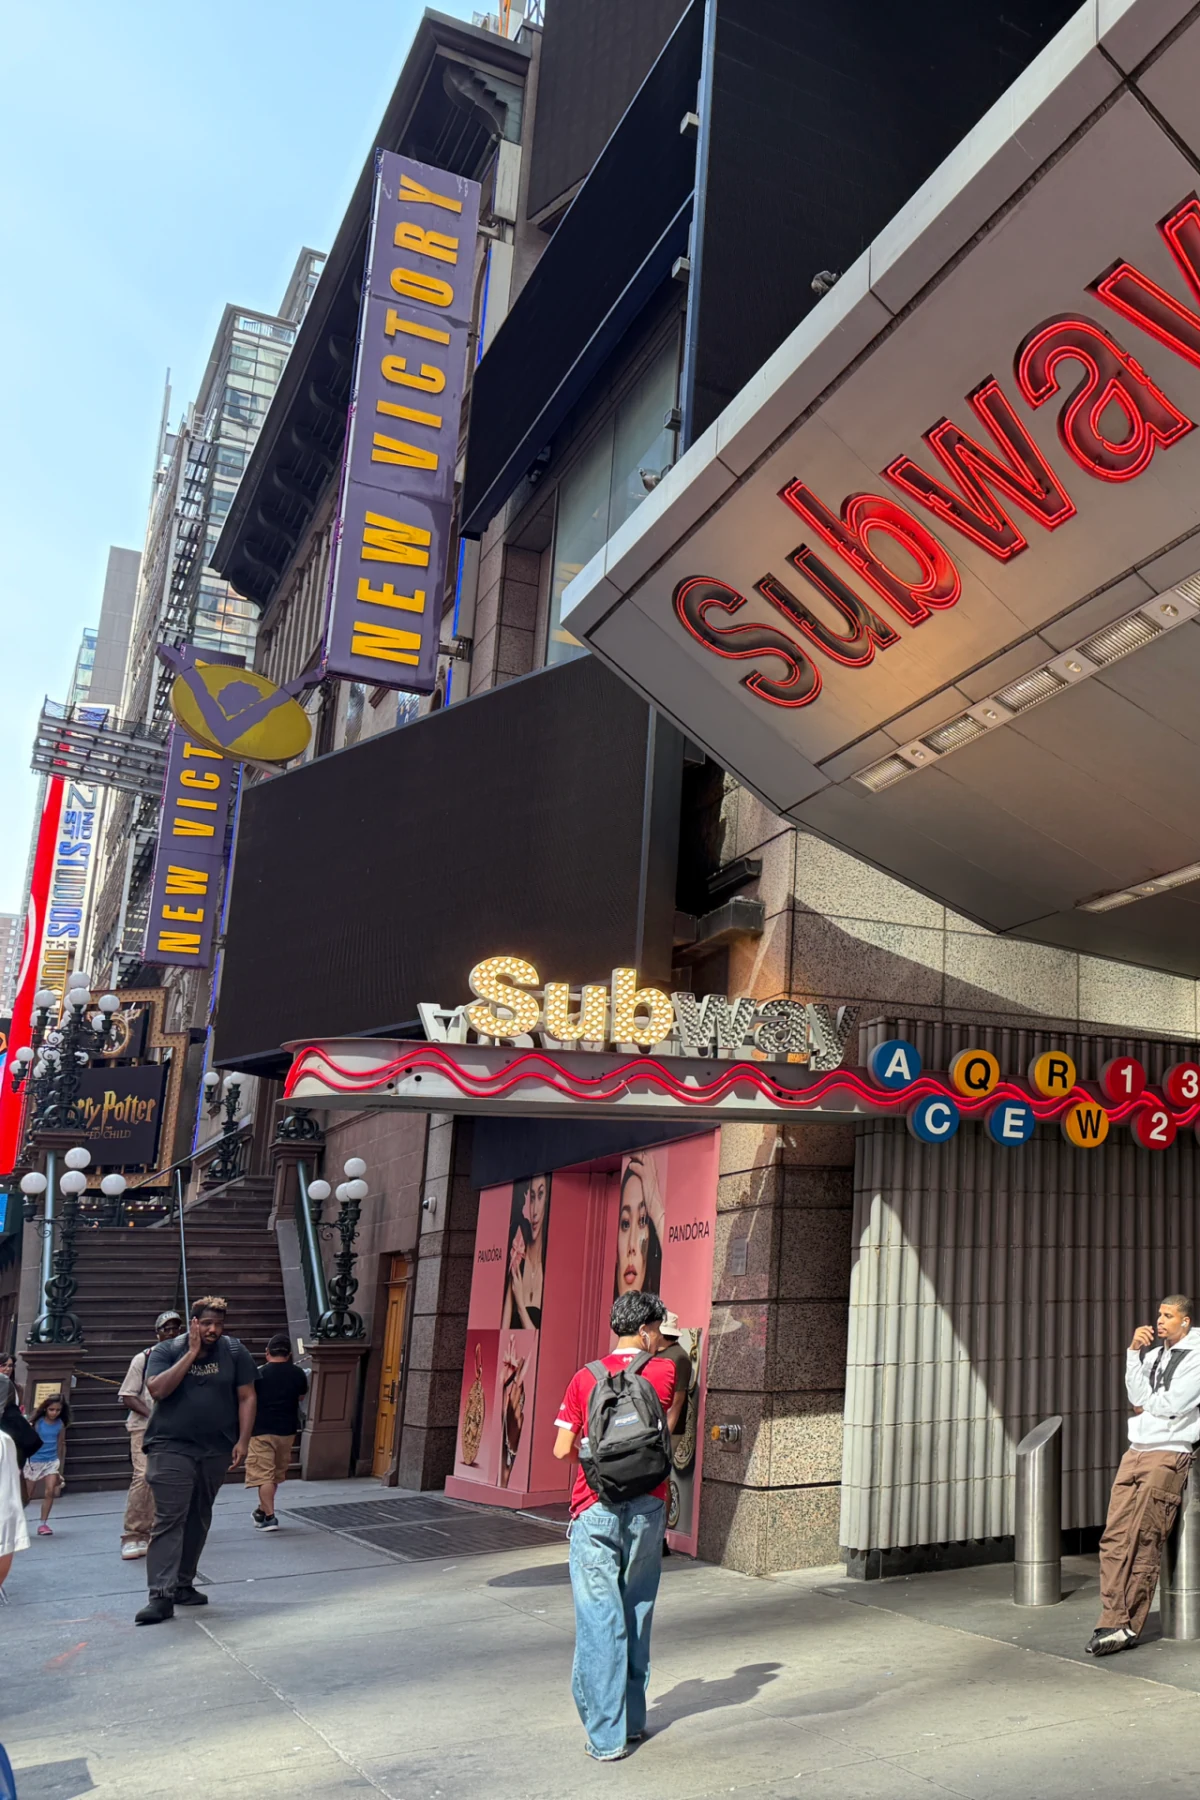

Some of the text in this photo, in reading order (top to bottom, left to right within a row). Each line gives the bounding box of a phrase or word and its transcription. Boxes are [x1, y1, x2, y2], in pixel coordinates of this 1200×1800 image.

[350, 173, 464, 666] NEW VICTORY
[157, 741, 224, 954] NEW VICT
[47, 841, 92, 938] STUDIOS
[40, 949, 69, 1001] DUK
[465, 956, 862, 1072] Subway
[884, 1049, 912, 1080] A
[964, 1057, 991, 1090] Q
[1047, 1059, 1068, 1089] R
[1120, 1065, 1134, 1093] 1
[1182, 1069, 1199, 1099] 3
[101, 1090, 156, 1134] Potter
[103, 1130, 131, 1139] CHILD
[924, 1103, 951, 1135] C
[1002, 1108, 1026, 1138] E
[1075, 1109, 1103, 1139] W
[1149, 1112, 1168, 1142] 2
[477, 1245, 503, 1263] PANDORA
[669, 1217, 710, 1243] PANDORA
